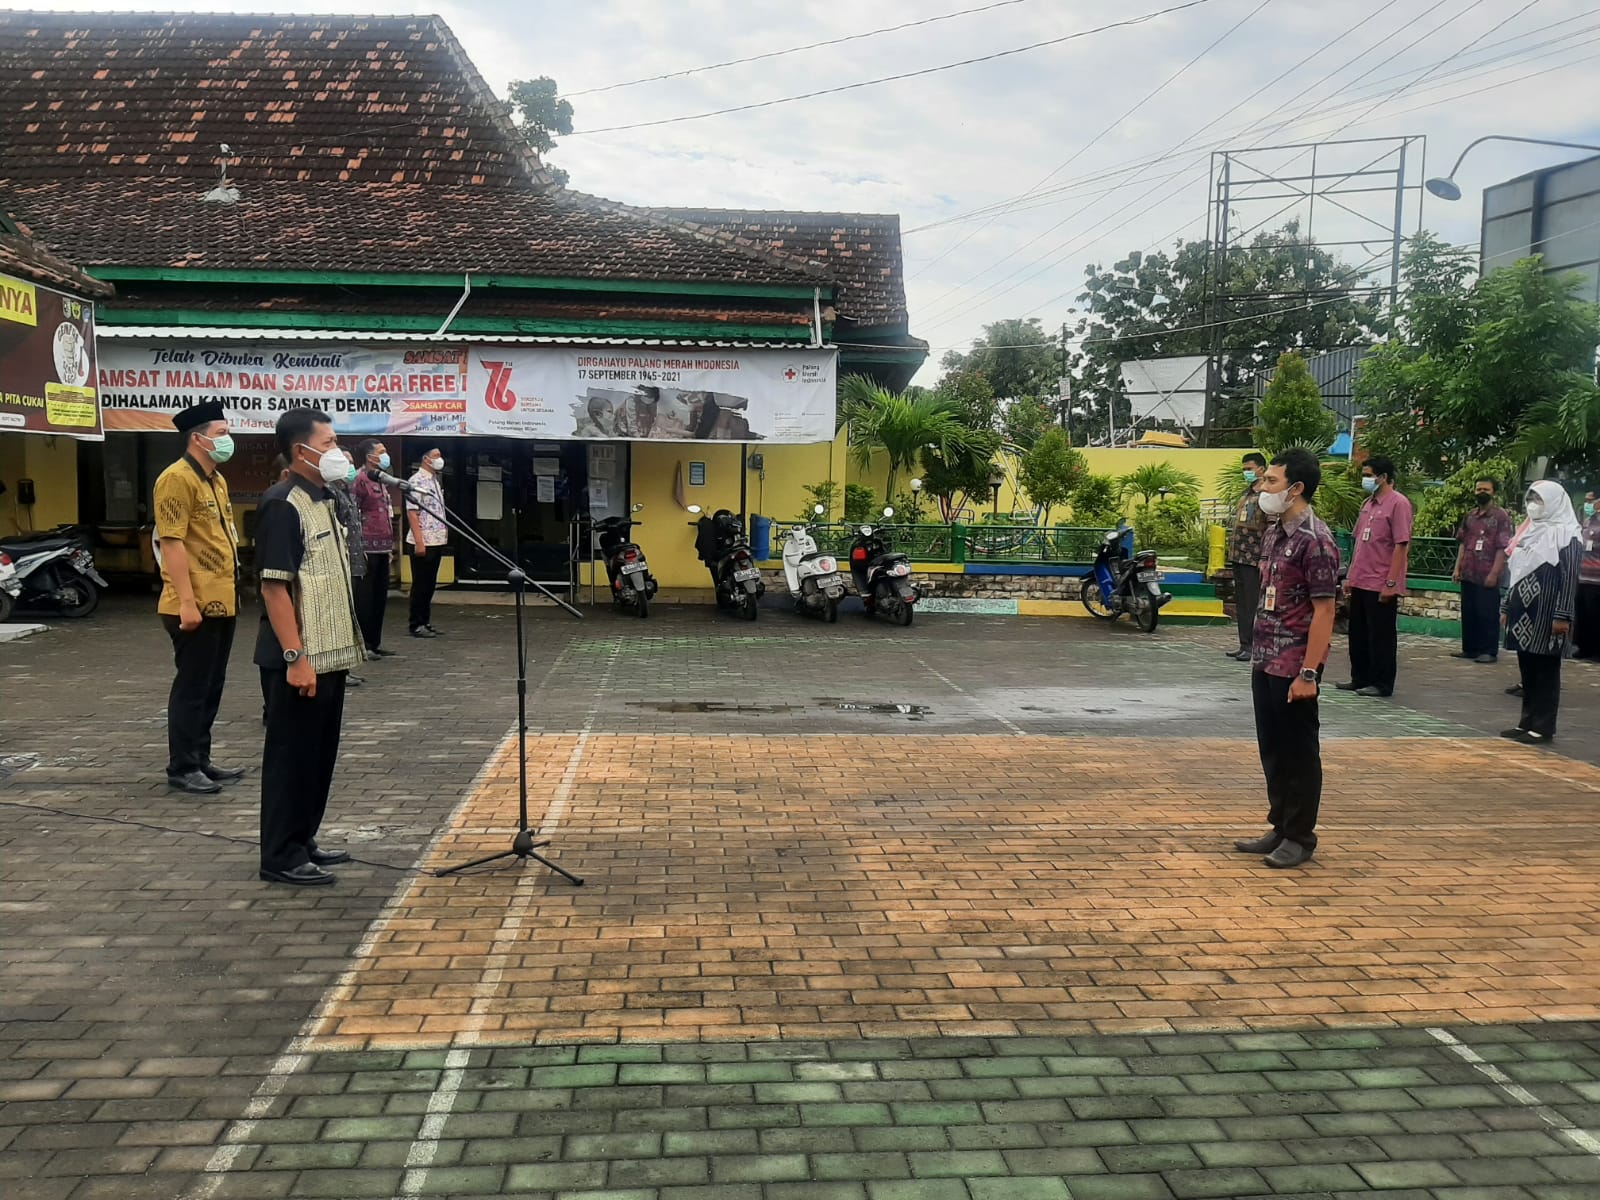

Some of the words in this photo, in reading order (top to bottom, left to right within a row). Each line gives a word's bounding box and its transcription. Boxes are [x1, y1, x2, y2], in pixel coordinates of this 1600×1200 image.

[149, 349, 195, 365] Telah
[200, 350, 264, 366] Dibuka
[272, 352, 343, 369] Kembali
[404, 350, 459, 365] SAMSAT
[577, 357, 626, 367] DIRGAHAYU
[628, 358, 661, 369] PALANG
[663, 359, 693, 370] MERAH
[695, 360, 740, 370] INDONESIA
[166, 370, 232, 388] MALAM
[240, 372, 277, 391] DAN
[283, 374, 359, 392] SAMSAT
[365, 374, 403, 392] CAR
[409, 374, 456, 392] FREE
[578, 369, 587, 379] 17
[588, 370, 637, 380] SEPTEMBER
[639, 371, 681, 382] 1945-2021
[5, 393, 21, 405] PITA
[22, 395, 44, 408] CUKAI
[102, 394, 193, 409] DIHALAMAN
[268, 397, 330, 412] SAMSAT
[336, 399, 392, 413] DEMAK
[409, 402, 442, 410] SAMSAT
[445, 402, 463, 410] CAR
[430, 414, 449, 422] Hari
